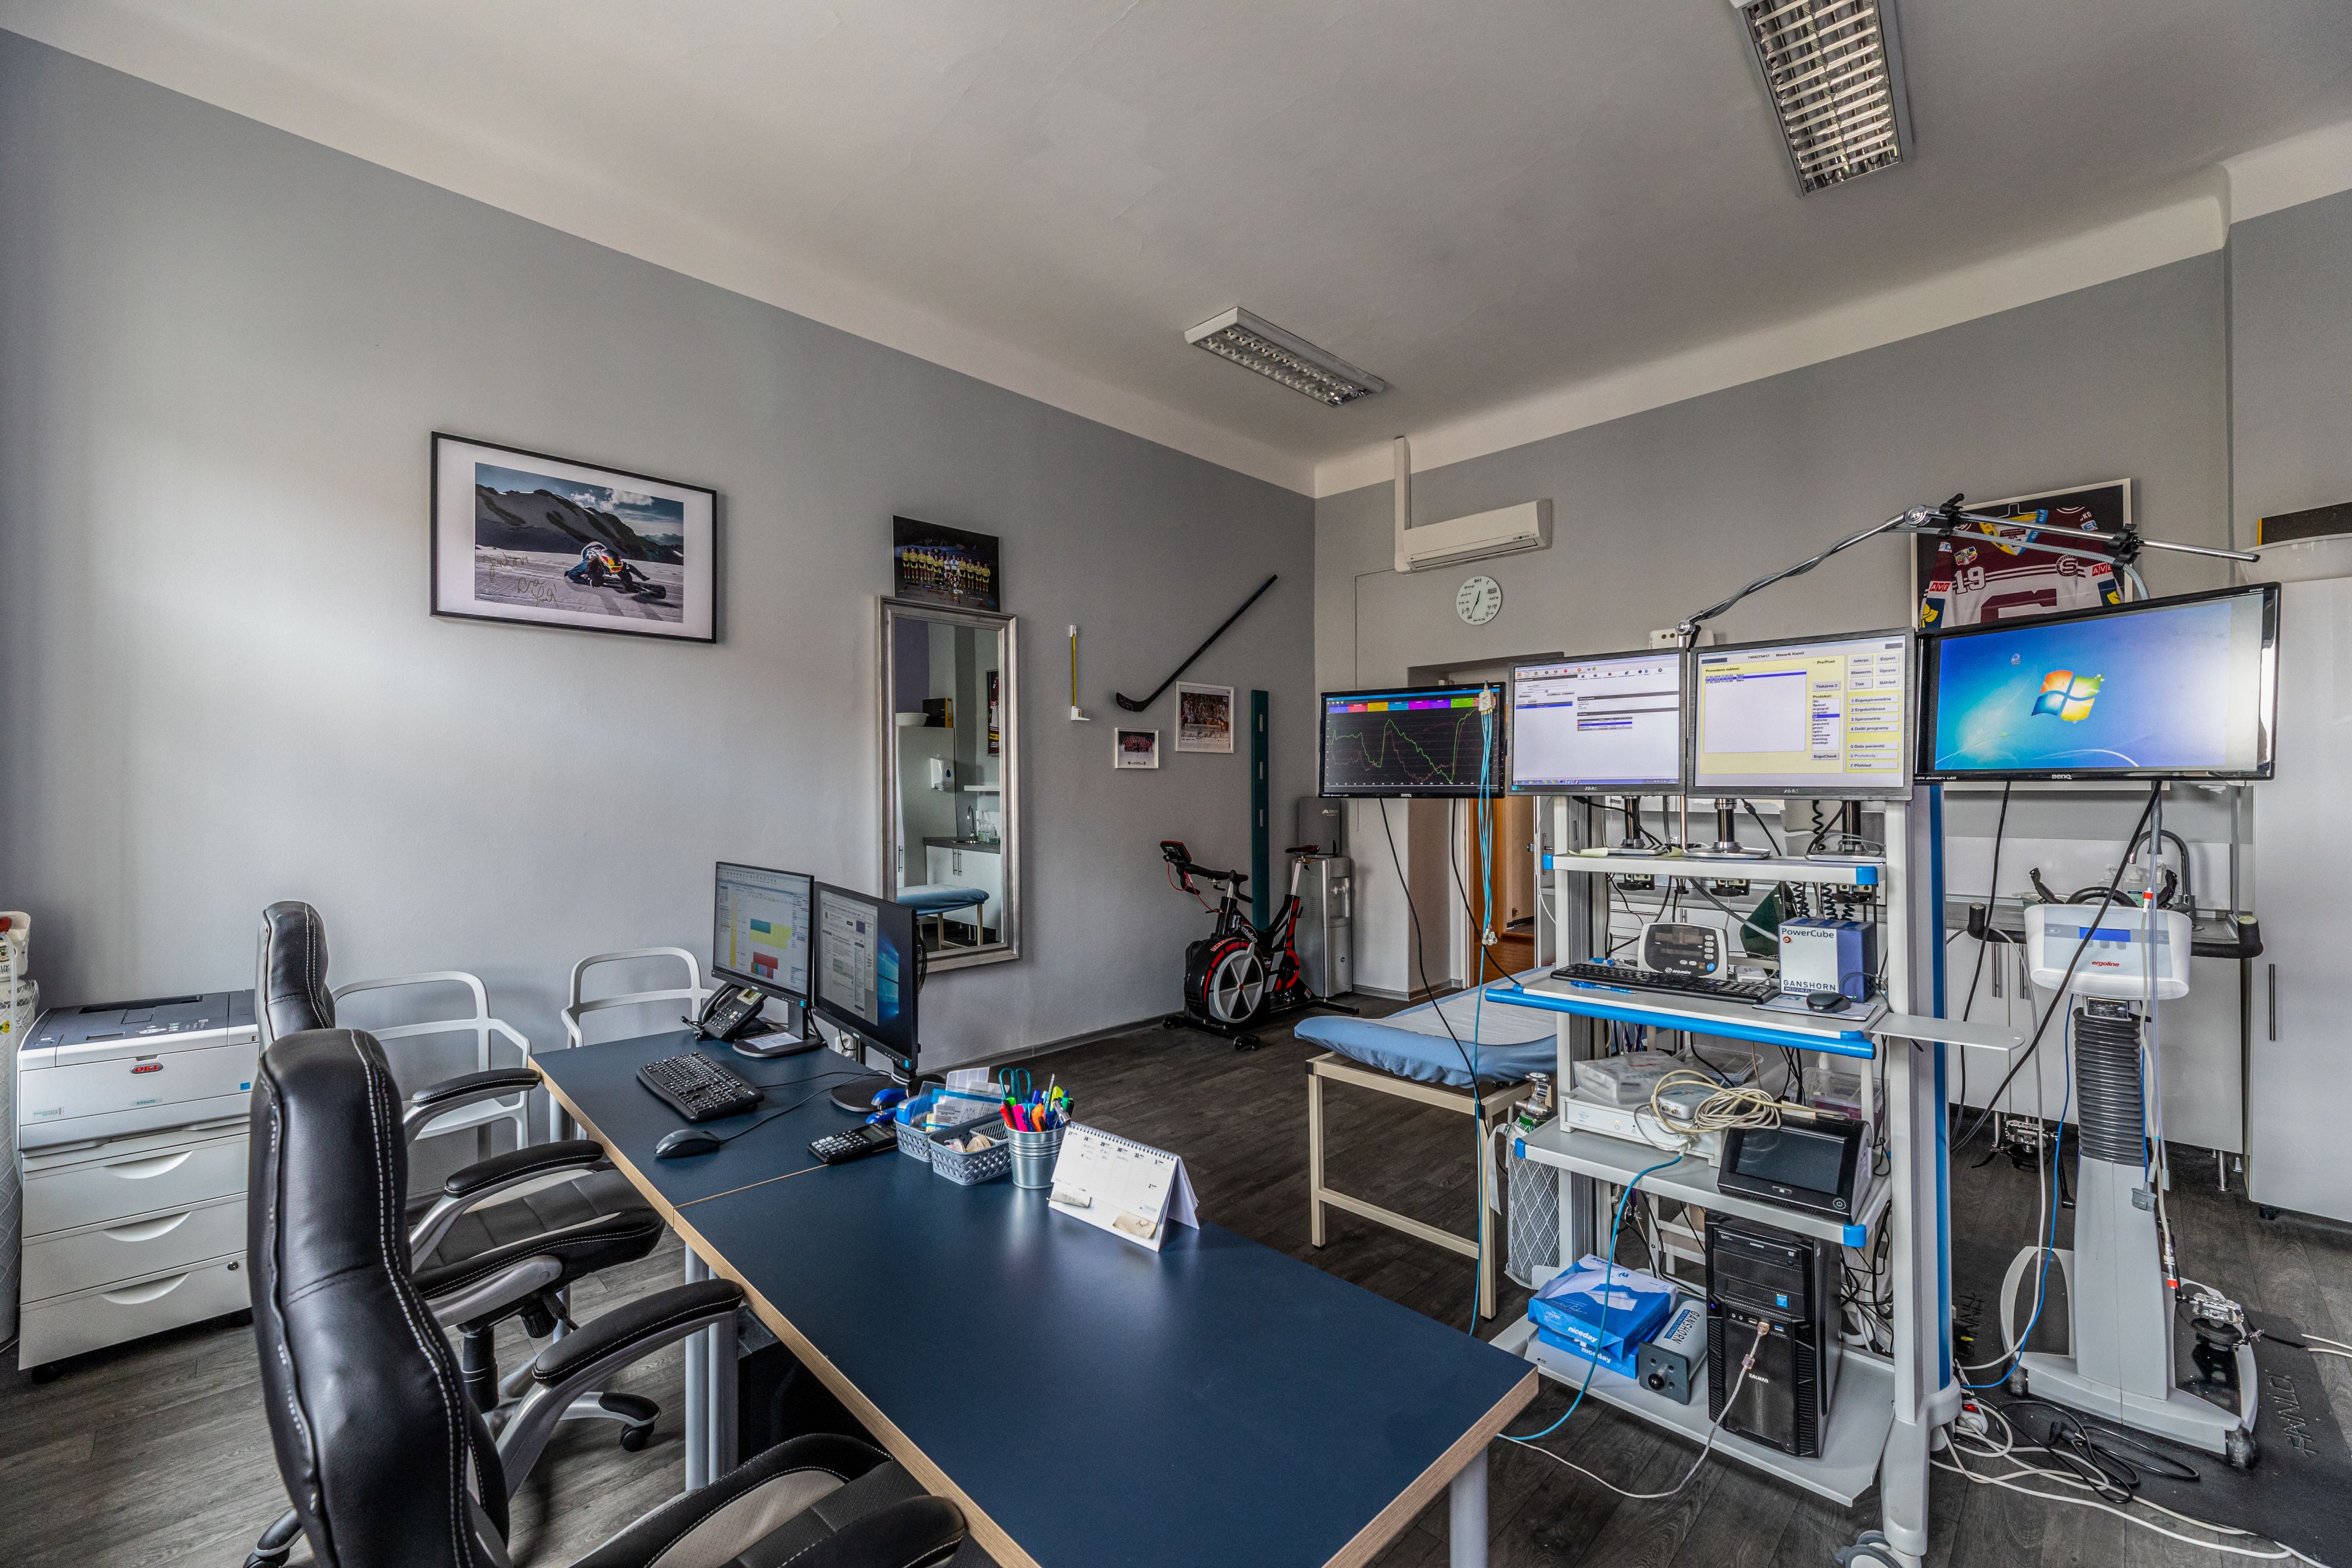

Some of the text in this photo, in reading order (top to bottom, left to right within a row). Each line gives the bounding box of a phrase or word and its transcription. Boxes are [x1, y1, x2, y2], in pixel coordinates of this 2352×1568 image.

[2093, 564, 2112, 574] AVE
[1954, 566, 1986, 594] 19
[1930, 583, 1949, 591] AVE
[1782, 928, 1834, 938] PowerCube
[1783, 980, 1836, 991] GANSHORN
[1671, 1310, 1700, 1345] GANSHORN
[1568, 1326, 1598, 1343] niceday
[1748, 1373, 1769, 1383] ZALMAN
